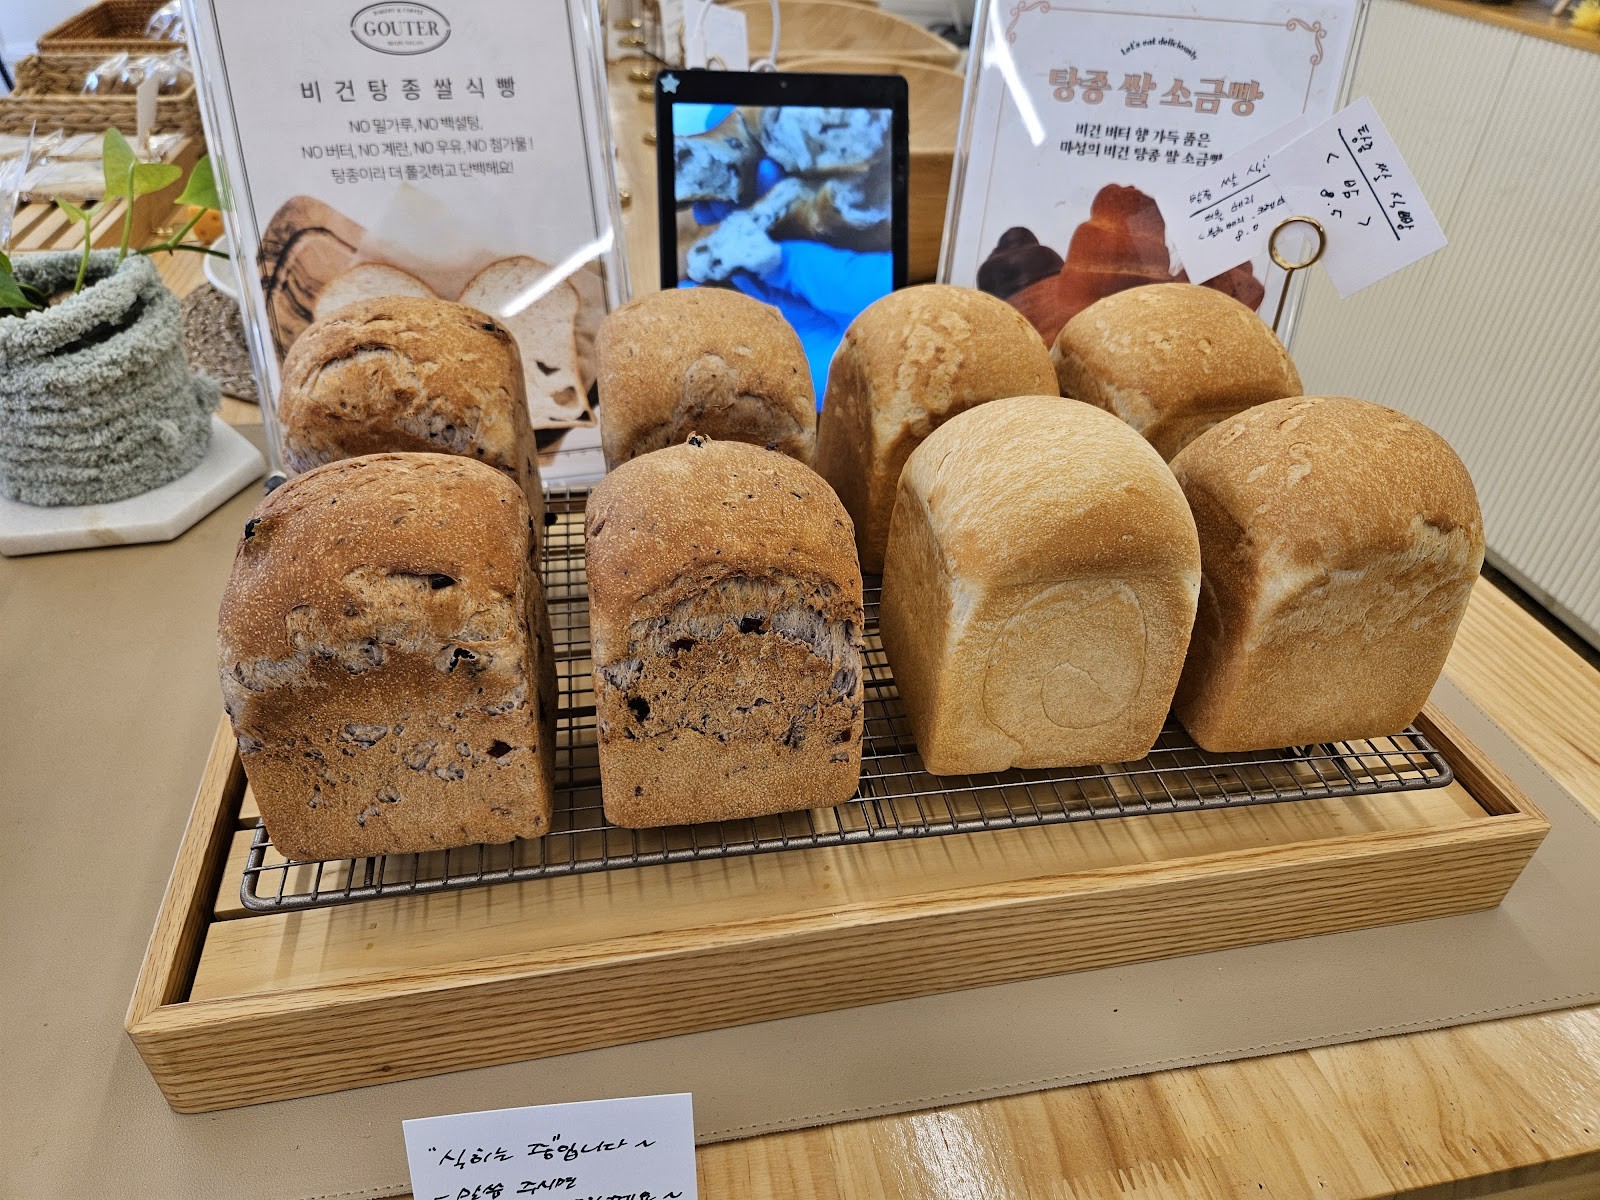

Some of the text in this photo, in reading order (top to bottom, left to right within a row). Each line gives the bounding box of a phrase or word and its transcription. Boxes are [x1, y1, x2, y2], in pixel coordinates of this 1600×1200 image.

[363, 21, 440, 37] GOUTER
[1142, 37, 1156, 46] eat
[1049, 66, 1264, 117] 탕종 쌀 소금빵
[349, 119, 371, 133] NO
[417, 117, 439, 131] NO
[1075, 122, 1211, 148] 비건 버터 향 가득 품은
[301, 145, 324, 159] NO
[358, 142, 380, 157] NO
[413, 141, 435, 155] NO
[466, 138, 488, 152] NO
[1060, 140, 1101, 157] 마성의
[1103, 144, 1130, 161] 비건
[1134, 147, 1160, 163] 탕종
[1164, 149, 1180, 165] 쌀
[331, 165, 386, 184] 탕종이라
[388, 165, 403, 180] 더
